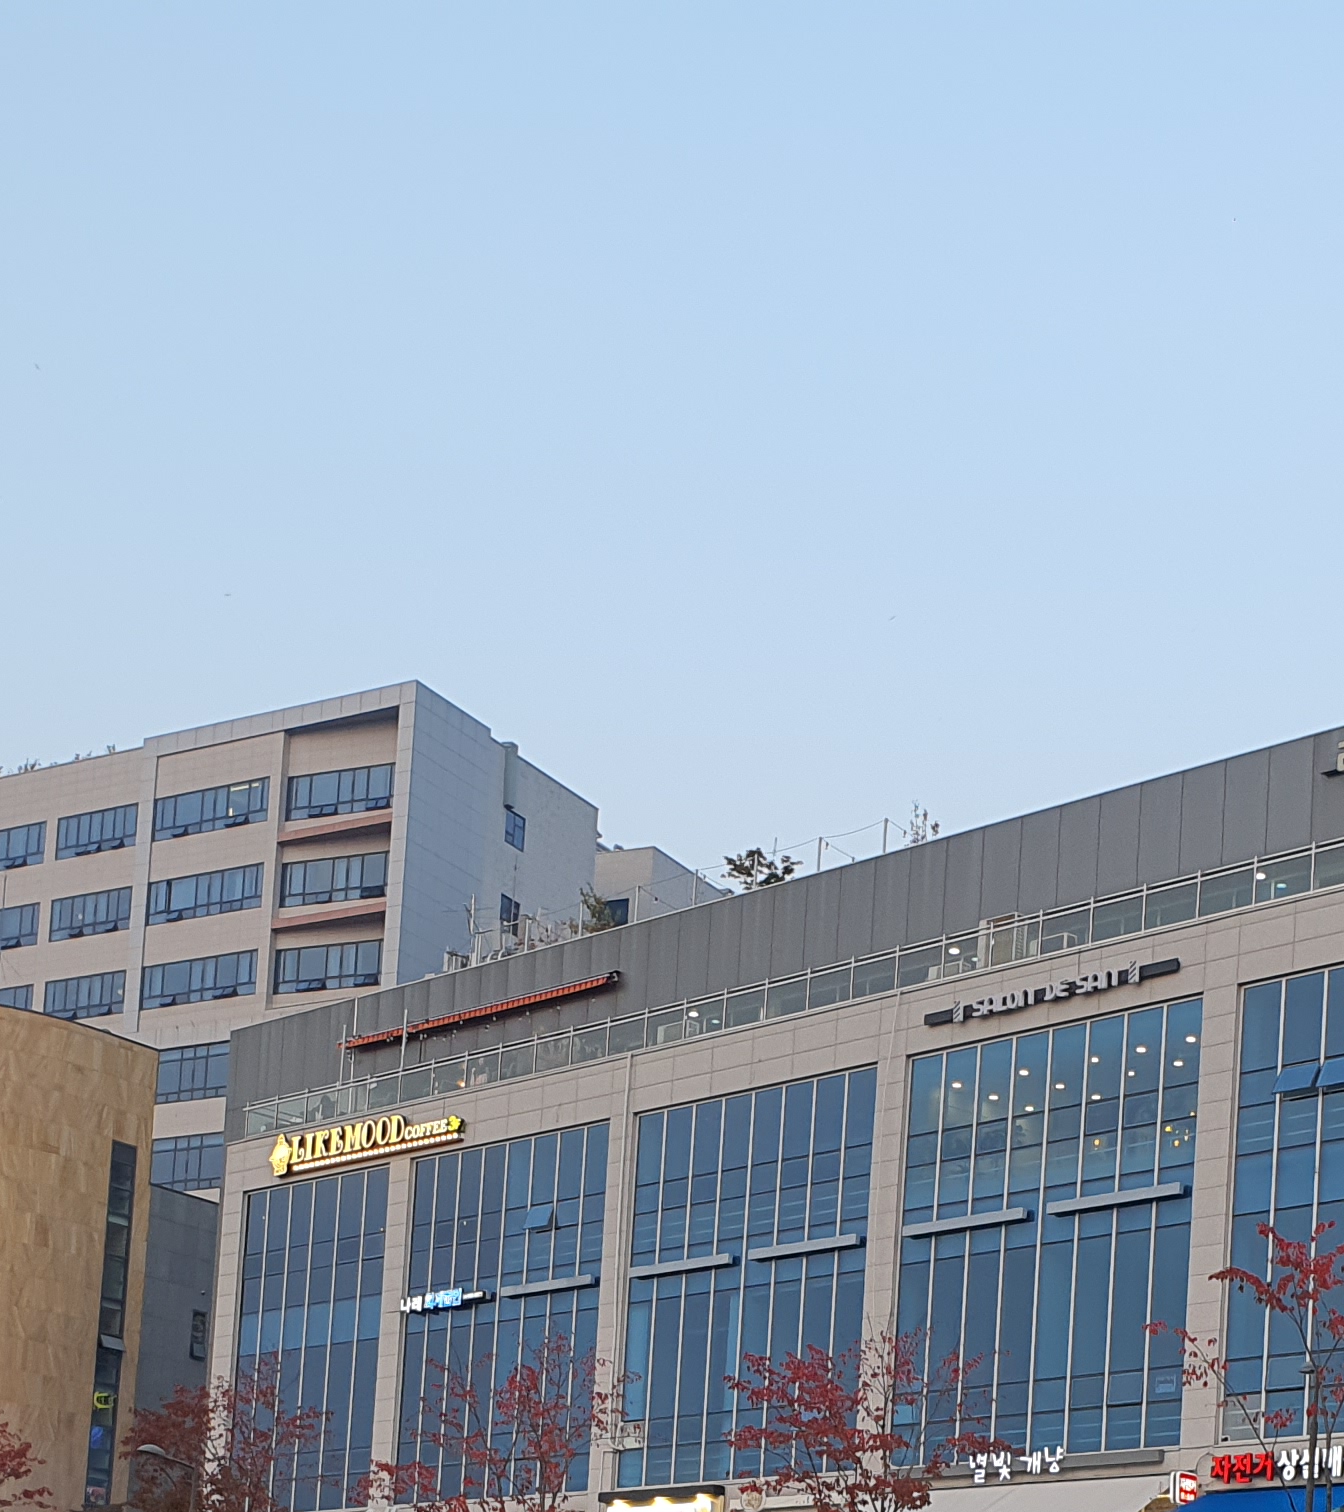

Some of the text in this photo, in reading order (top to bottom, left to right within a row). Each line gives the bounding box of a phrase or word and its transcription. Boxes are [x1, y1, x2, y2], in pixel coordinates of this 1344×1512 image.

[972, 968, 1119, 1017] SALON DE SAN
[405, 1118, 448, 1140] COFFEE
[1210, 1451, 1275, 1485] 자전거
